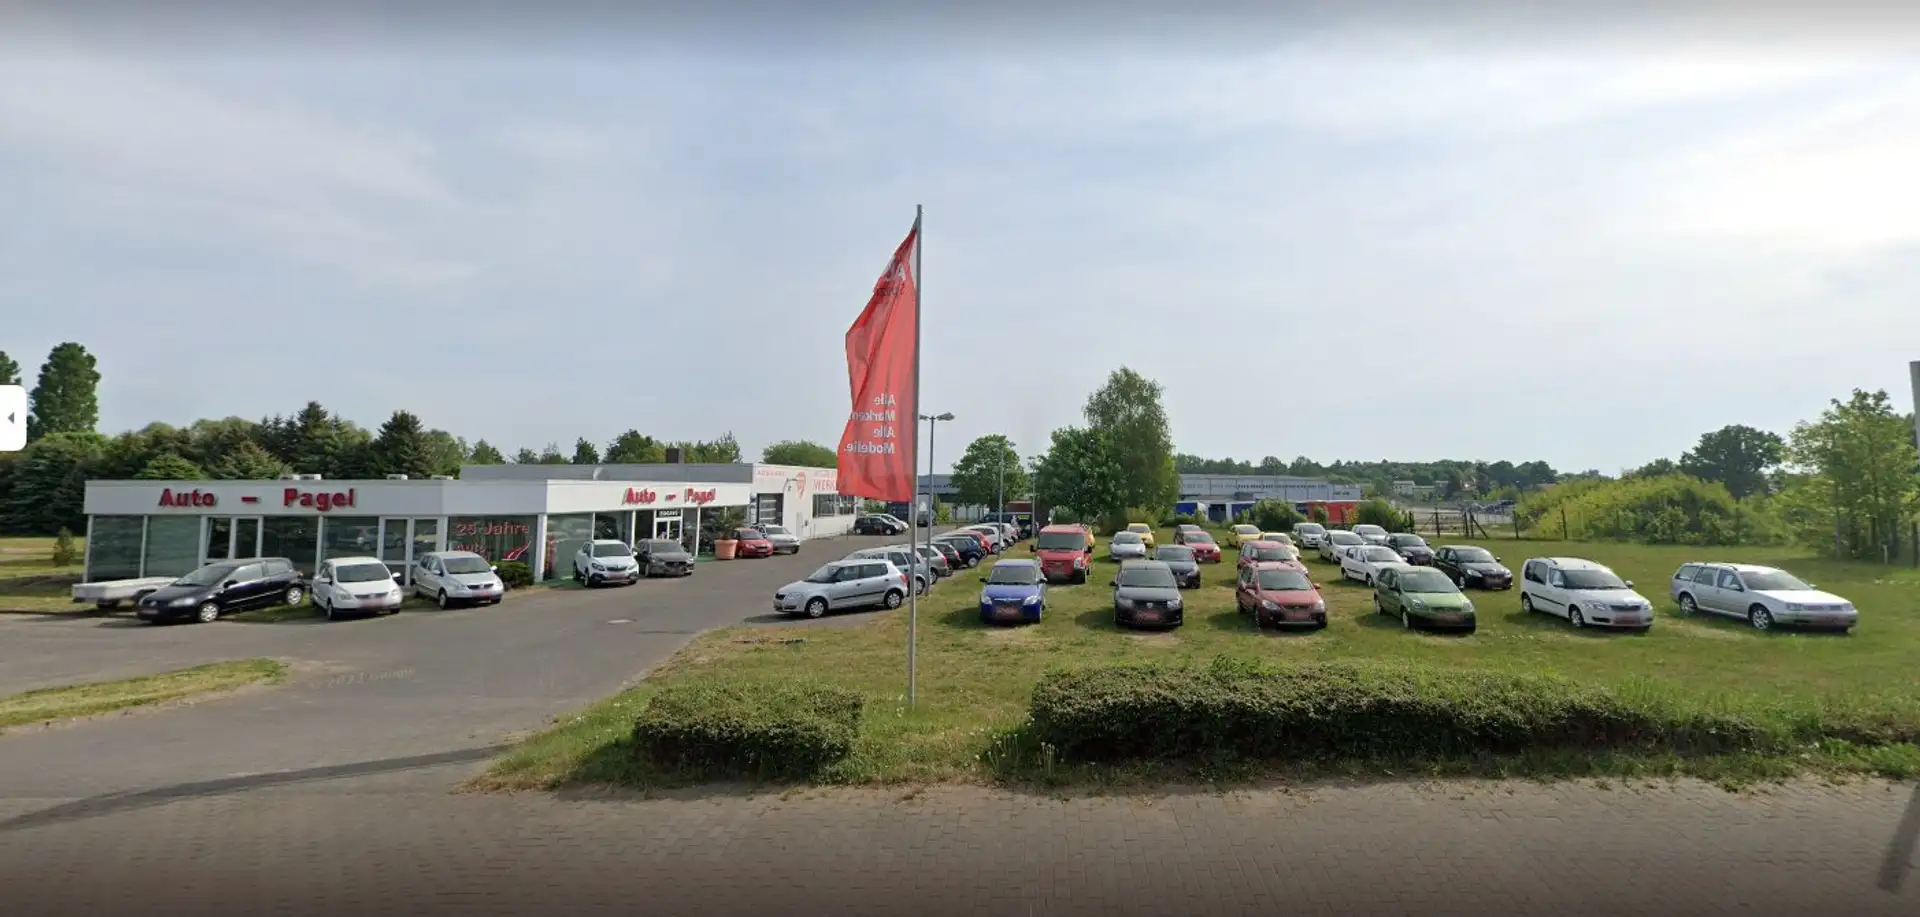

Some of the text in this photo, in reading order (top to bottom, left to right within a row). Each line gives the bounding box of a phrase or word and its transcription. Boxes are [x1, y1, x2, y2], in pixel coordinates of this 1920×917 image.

[158, 487, 217, 508] Auto
[283, 487, 355, 512] Pagel
[623, 487, 656, 504] Auto
[684, 487, 716, 505] Pagel
[457, 521, 530, 537] 25 Jahre
